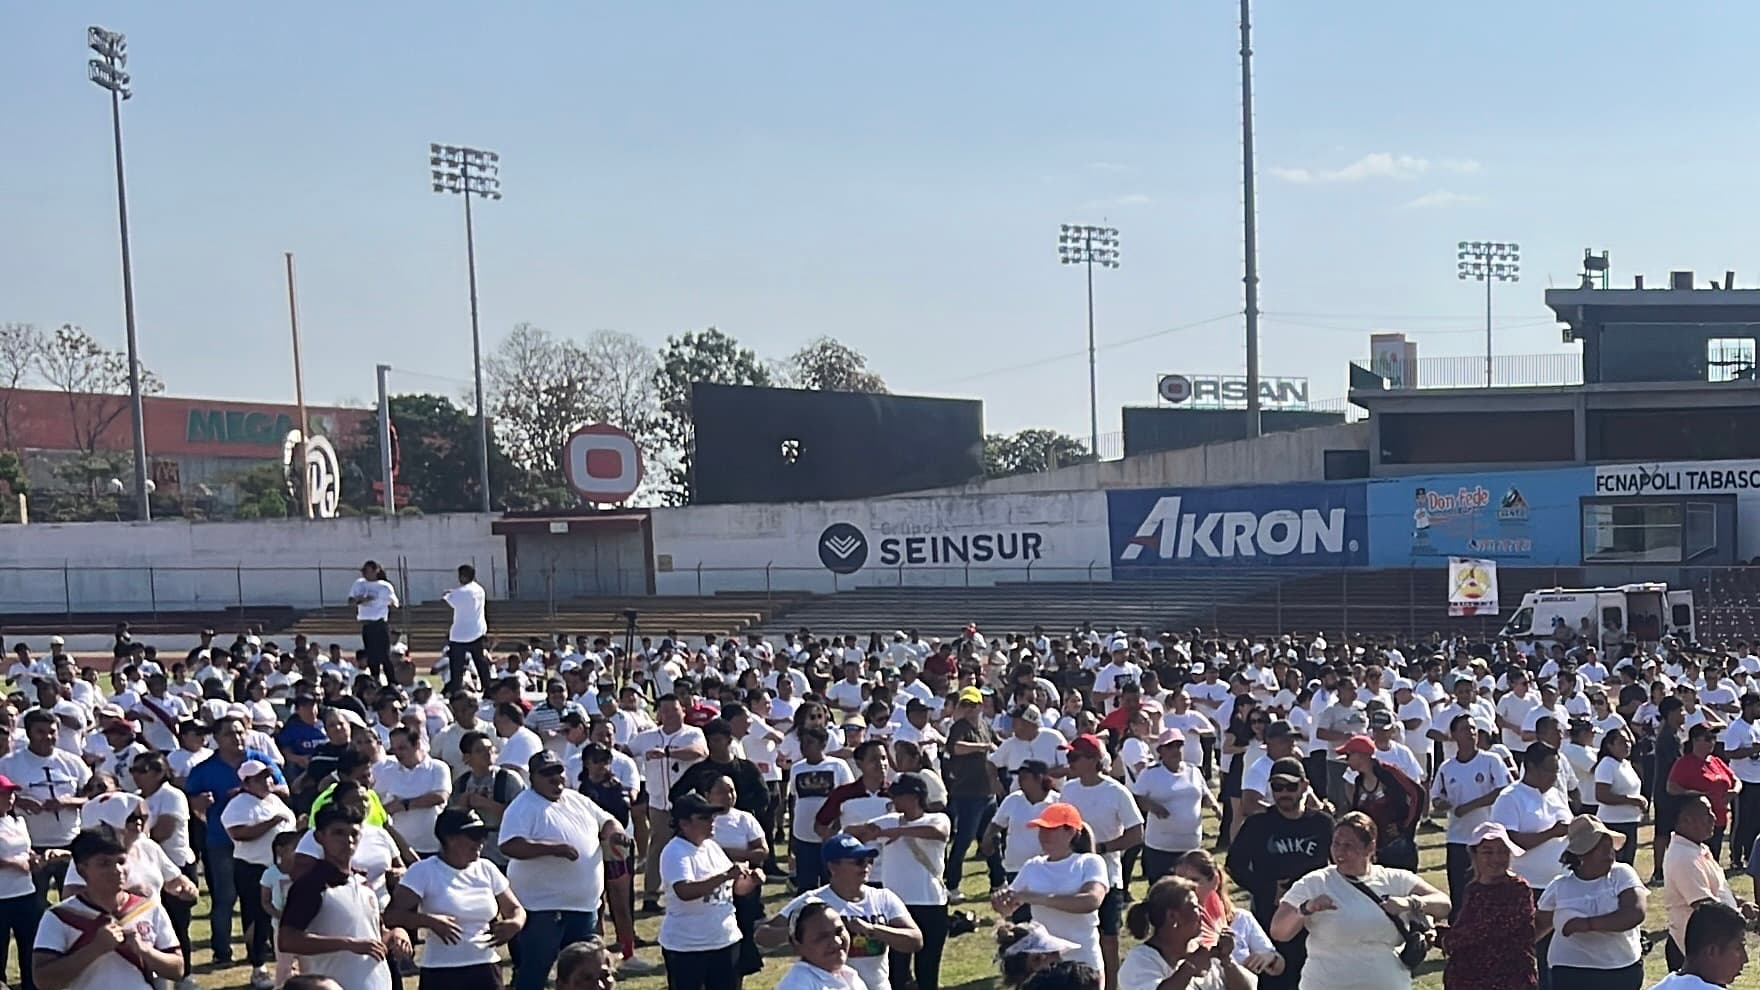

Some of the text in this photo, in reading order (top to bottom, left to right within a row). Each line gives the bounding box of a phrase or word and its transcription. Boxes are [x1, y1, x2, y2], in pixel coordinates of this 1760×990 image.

[1158, 374, 1308, 403] ORSAN
[1427, 491, 1457, 512] Don
[1119, 496, 1346, 560] AKRON
[879, 532, 1042, 566] SEINSUR
[1275, 837, 1318, 857] NIKE
